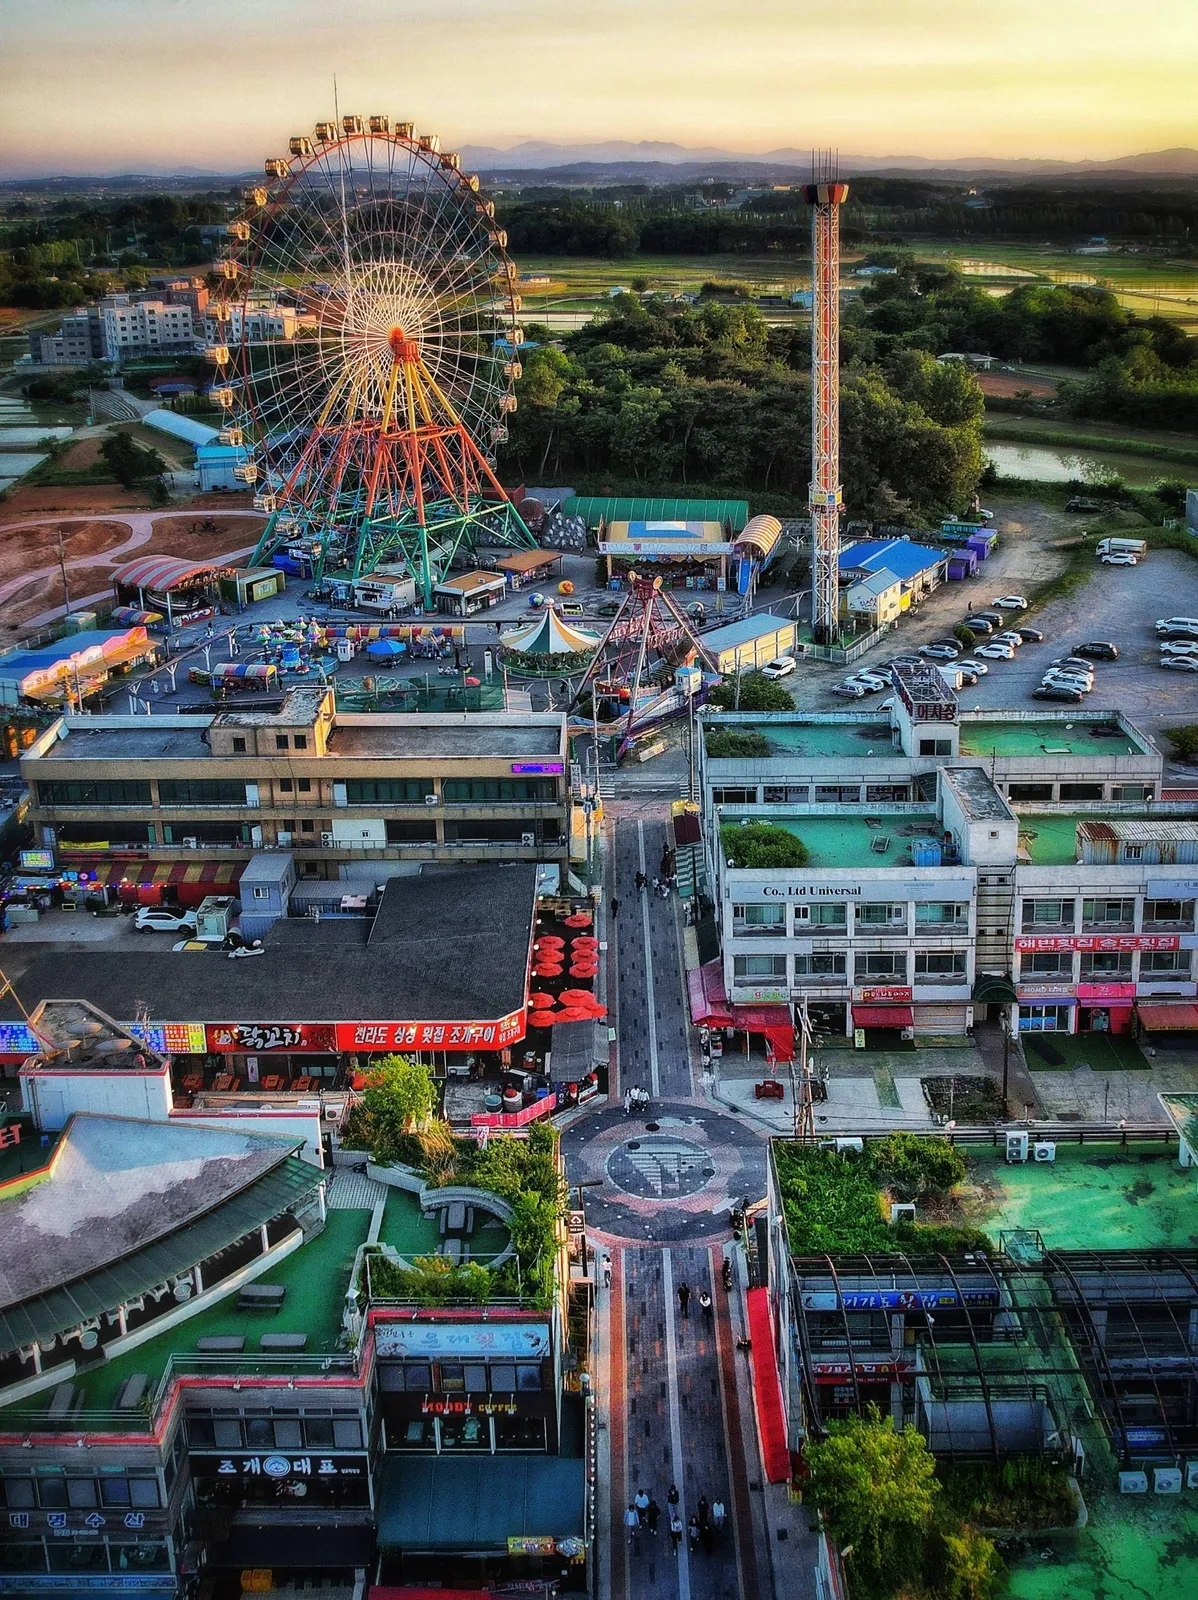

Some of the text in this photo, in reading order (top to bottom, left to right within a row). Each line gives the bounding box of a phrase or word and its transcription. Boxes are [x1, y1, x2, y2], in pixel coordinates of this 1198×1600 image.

[917, 704, 957, 721] 어시장
[763, 886, 862, 897] Co., Ltd Universal
[1018, 938, 1093, 948] 해변횟집
[1100, 937, 1175, 947] 송도횟집
[238, 1026, 300, 1049] 닭꼬치
[354, 1026, 388, 1044] 전라도
[217, 1457, 338, 1475] 조개 대표
[9, 1512, 146, 1528] 대명수산
